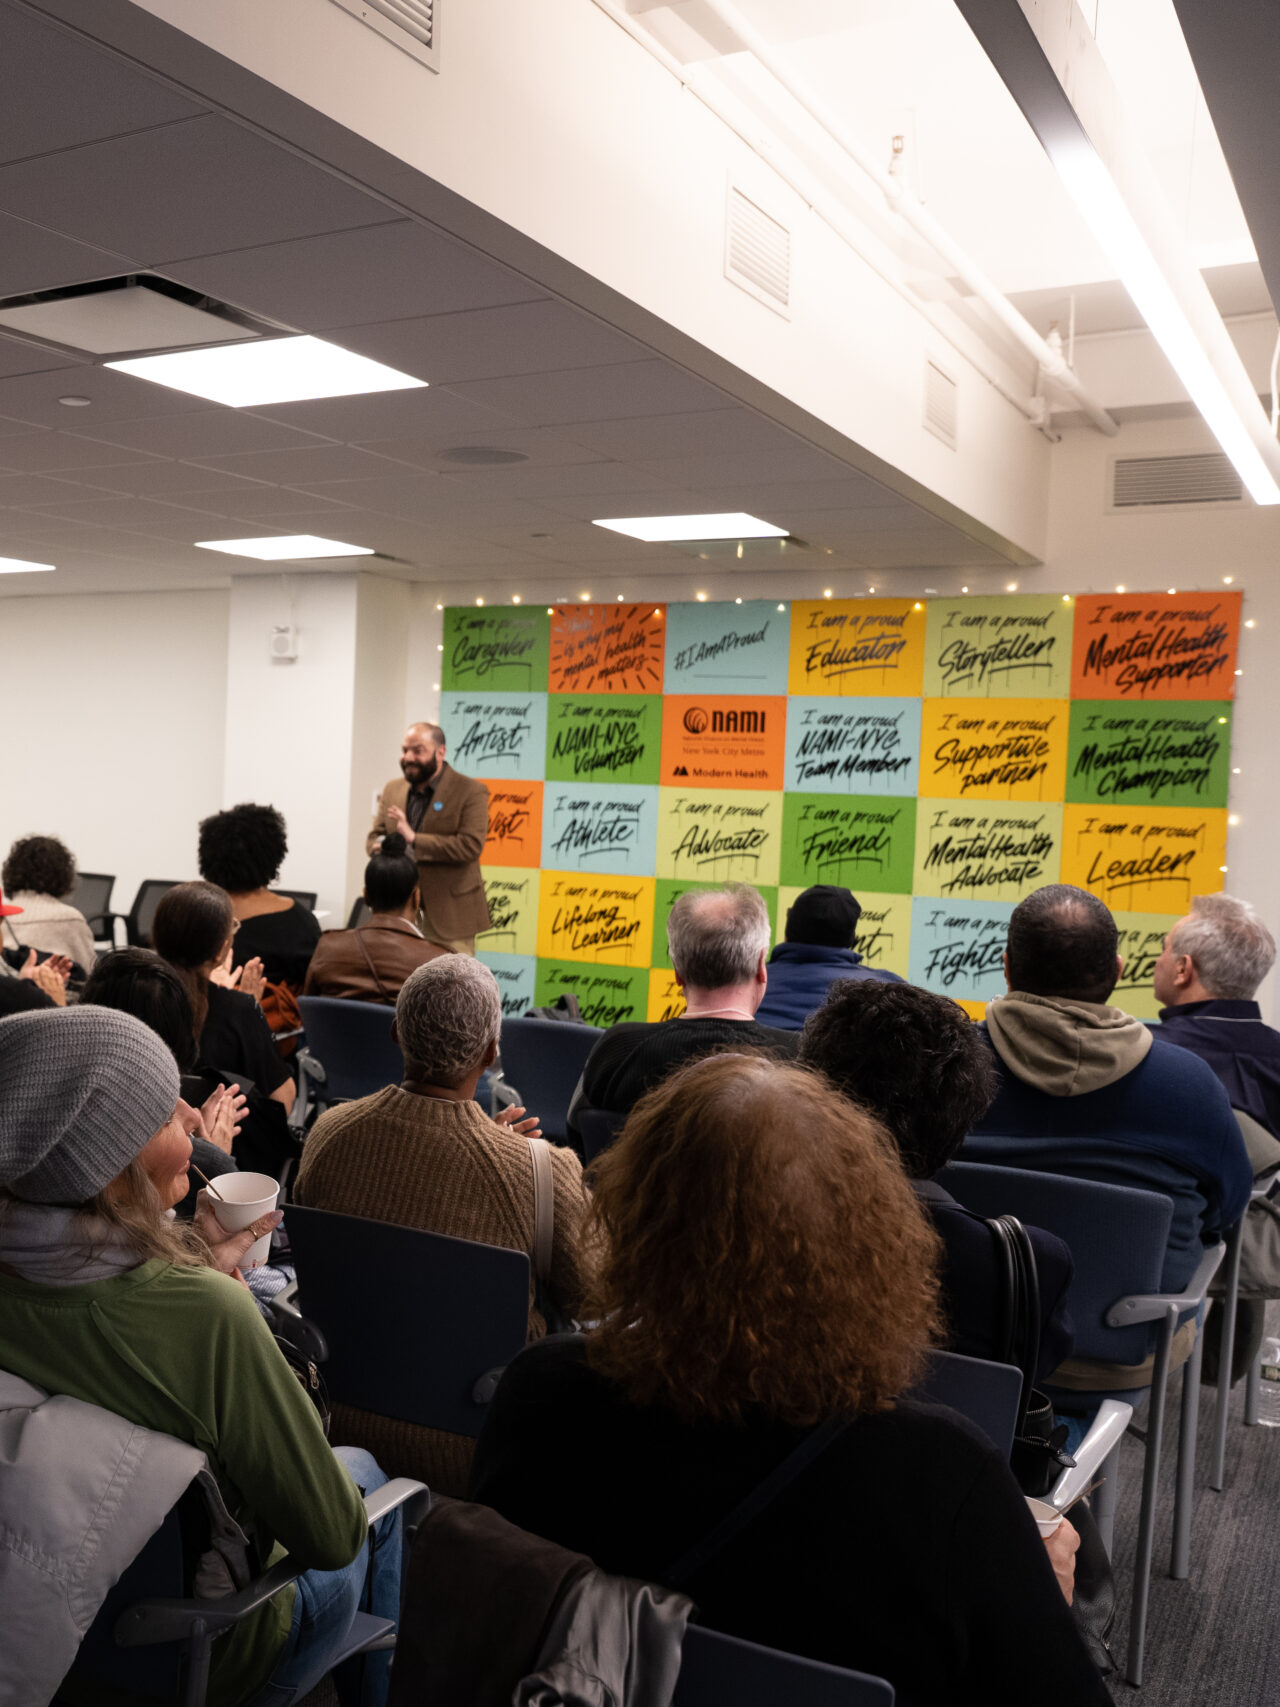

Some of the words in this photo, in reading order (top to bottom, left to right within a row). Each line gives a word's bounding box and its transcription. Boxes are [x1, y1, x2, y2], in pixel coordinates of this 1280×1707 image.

[806, 611, 824, 629] I
[822, 614, 848, 629] am
[849, 614, 861, 627] a
[858, 610, 911, 634] proud
[942, 611, 961, 628] I
[960, 614, 987, 628] am
[989, 614, 1001, 627] a
[996, 611, 1055, 635] proud
[1088, 605, 1113, 624] I
[1110, 609, 1143, 624] am
[1144, 610, 1159, 623] a
[1154, 603, 1221, 627] proud
[452, 635, 537, 676] Caregiver
[563, 645, 601, 678] mental
[604, 629, 646, 662] health
[673, 619, 771, 671] #IAmAProud
[805, 632, 908, 674] Educator
[938, 632, 1056, 683] Storyteller
[1083, 626, 1166, 677] Mental
[1160, 621, 1228, 660] Health
[598, 653, 649, 680] matters
[1116, 654, 1229, 694] Supporter
[451, 701, 465, 715] I
[464, 704, 482, 717] am
[483, 705, 493, 715] a
[489, 701, 532, 720] proud
[558, 702, 573, 718] I
[573, 706, 593, 718] am
[594, 707, 603, 717] a
[601, 703, 647, 720] proud
[712, 710, 766, 733] NAMI
[800, 710, 818, 725] I
[817, 713, 843, 727] am
[843, 714, 854, 726] a
[850, 711, 905, 732] proud
[937, 713, 959, 731] I
[956, 717, 985, 733] am
[987, 718, 1000, 731] a
[996, 715, 1056, 738] proud
[454, 720, 531, 761] Artist
[552, 721, 639, 759] NAMI-NYC
[1082, 715, 1102, 732] I
[1102, 717, 1135, 732] am
[1135, 718, 1149, 731] a
[1145, 715, 1215, 737] proud
[574, 744, 645, 774] Volunteer
[795, 730, 901, 758] NAMI-NYC
[933, 733, 1050, 774] Supportive
[1072, 738, 1151, 778] Mental
[1145, 732, 1220, 764] Health
[693, 768, 732, 777] Modern
[735, 768, 768, 778] Health
[795, 760, 841, 784] Team
[837, 751, 912, 779] Member
[959, 760, 1048, 794] partner
[1096, 761, 1211, 799] Champion
[488, 791, 534, 810] proud
[553, 795, 568, 811] I
[568, 799, 590, 811] am
[592, 800, 602, 811] a
[600, 799, 645, 816] proud
[670, 798, 687, 814] I
[685, 802, 712, 815] am
[713, 803, 724, 815] a
[721, 802, 770, 821] proud
[799, 804, 816, 820] I
[814, 808, 840, 823] am
[840, 809, 851, 822] a
[848, 808, 901, 830] proud
[930, 810, 949, 830] I
[948, 814, 975, 831] am
[977, 815, 991, 829] a
[987, 814, 1046, 834] proud
[1078, 817, 1099, 834] I
[1098, 821, 1129, 834] am
[1130, 823, 1145, 836] a
[1140, 822, 1206, 840] proud
[550, 815, 639, 851] Athlete
[671, 824, 769, 861] Advocate
[803, 825, 891, 867] Friend
[923, 832, 995, 870] Mental
[988, 832, 1054, 860] Health
[1086, 845, 1197, 885] Leader
[940, 861, 1043, 892] Advocate
[550, 882, 565, 897] I
[565, 887, 587, 899] am
[589, 888, 599, 898] a
[597, 886, 643, 904] proud
[552, 904, 626, 935] Lifelong
[924, 910, 946, 927] I
[943, 917, 970, 931] am
[971, 919, 982, 930] a
[978, 919, 1011, 937] pro
[571, 920, 640, 951] Learner
[492, 968, 524, 982] roud
[924, 937, 1007, 986] Fighte
[544, 969, 562, 984] I
[559, 974, 581, 986] am
[581, 975, 591, 986] a
[588, 976, 633, 992] proud
